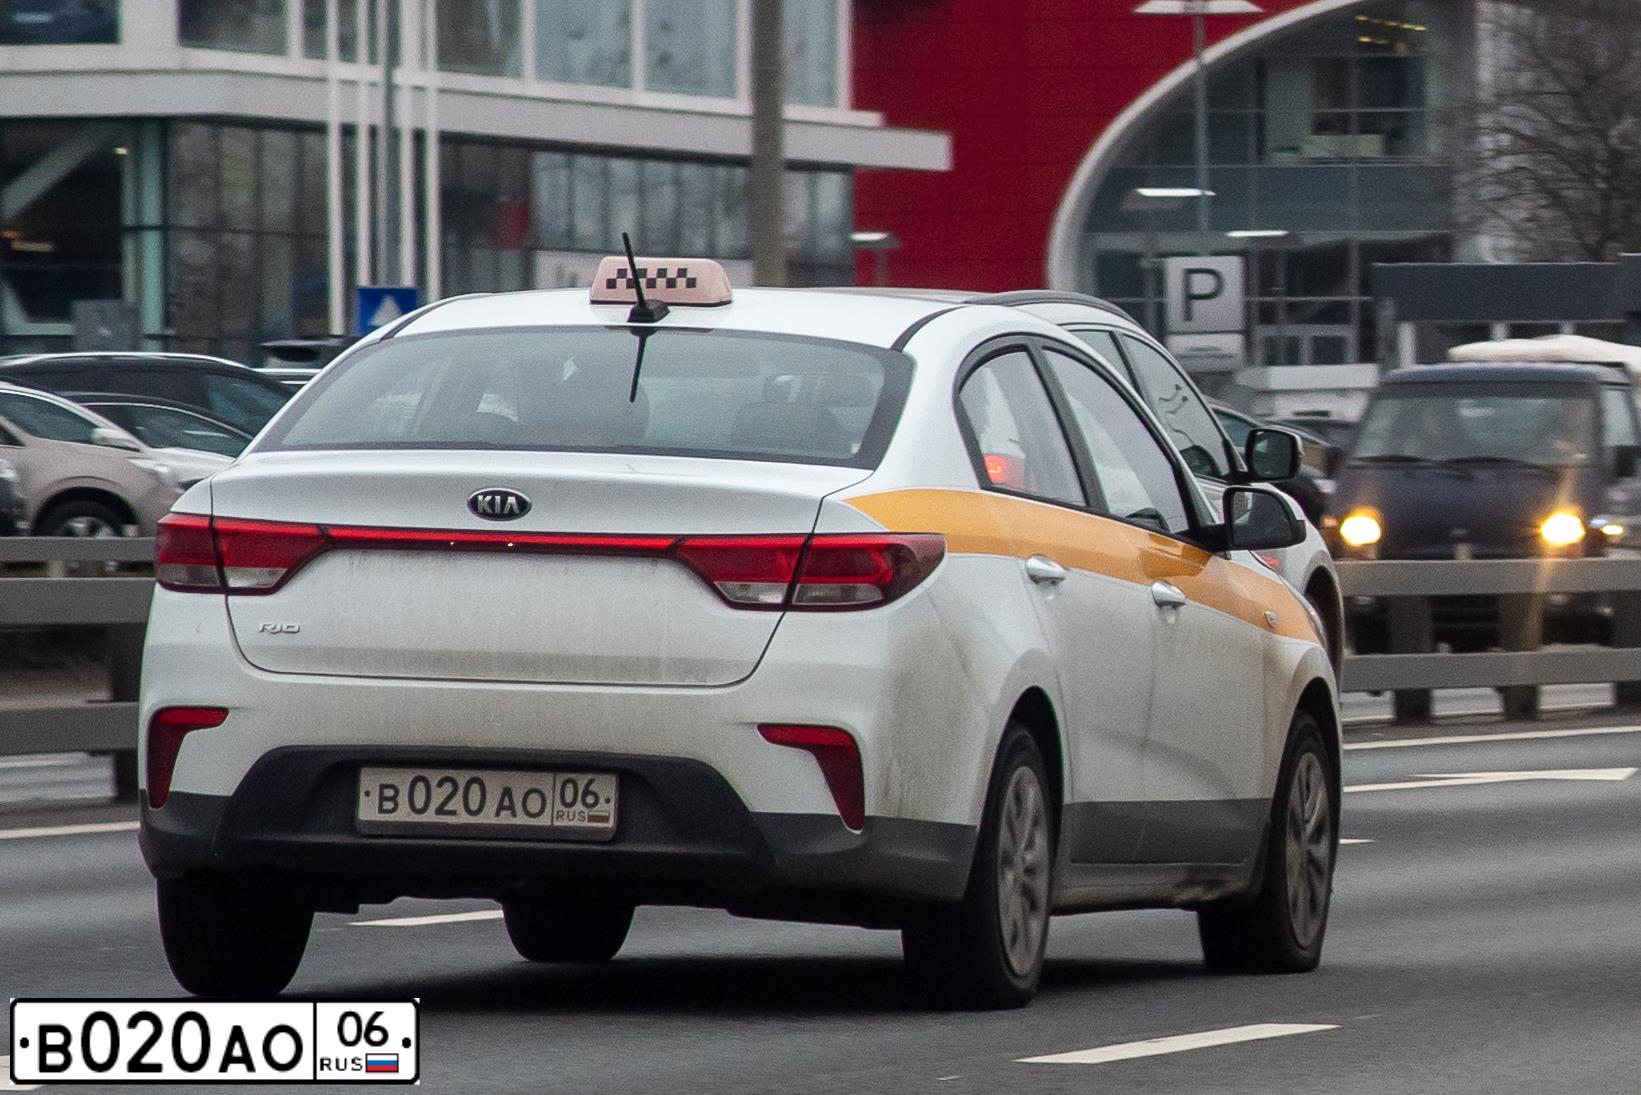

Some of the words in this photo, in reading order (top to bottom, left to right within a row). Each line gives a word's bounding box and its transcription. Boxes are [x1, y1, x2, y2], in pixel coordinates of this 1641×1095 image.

[1183, 267, 1224, 322] P
[476, 494, 521, 515] KIA
[259, 622, 302, 635] RIO
[560, 777, 600, 809] 06
[556, 809, 586, 822] RUS
